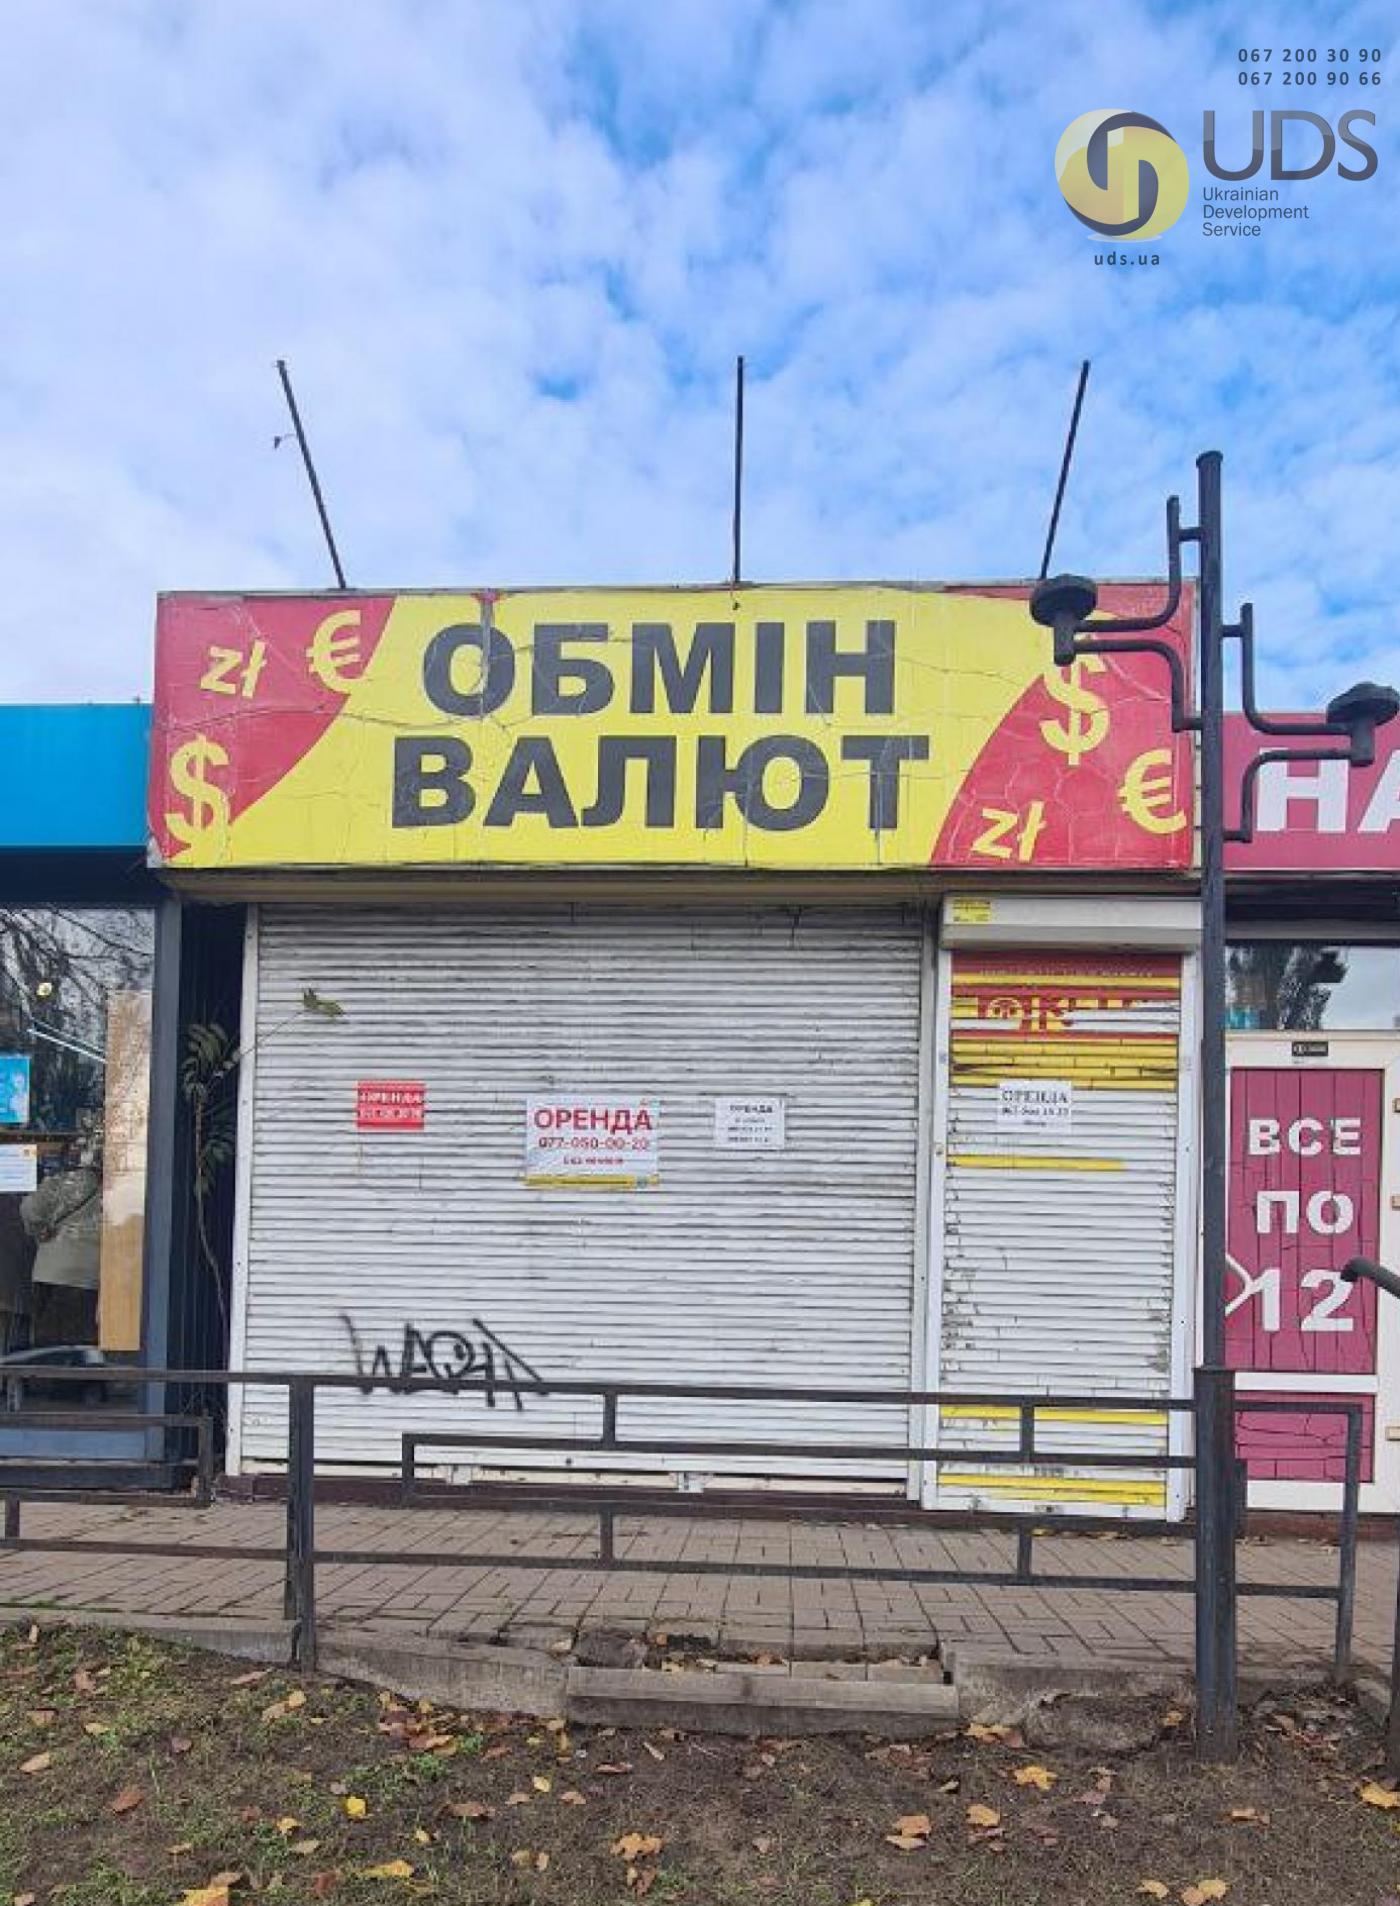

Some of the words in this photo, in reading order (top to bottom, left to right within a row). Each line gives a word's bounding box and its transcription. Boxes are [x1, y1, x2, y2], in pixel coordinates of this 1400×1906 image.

[200, 638, 270, 699] zł
[423, 619, 896, 718] ОБМІН
[391, 733, 929, 831] ВАЛЮТ
[971, 800, 1047, 862] zł
[534, 1107, 654, 1136] ОРЕНДА
[1248, 1117, 1362, 1157] ВСЕ
[1255, 1190, 1355, 1235] ПО
[1260, 1268, 1355, 1332] 12
